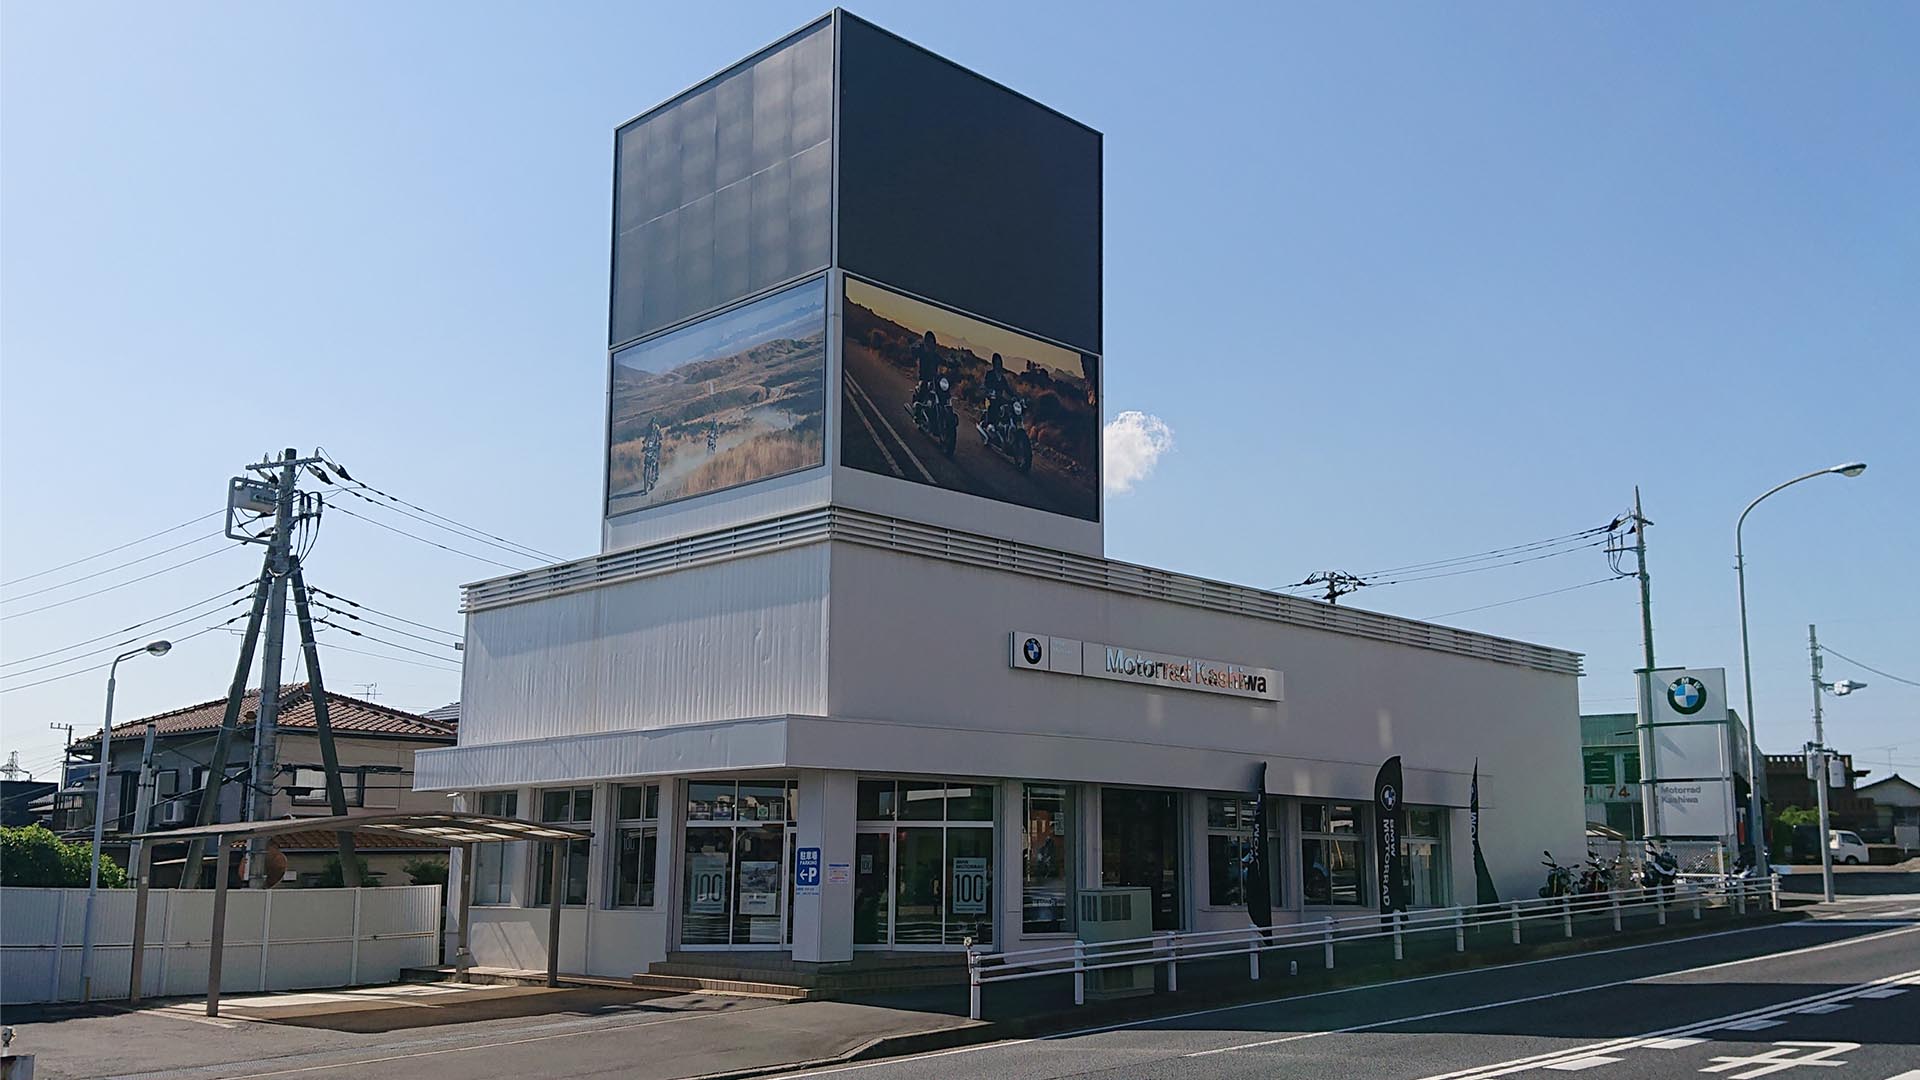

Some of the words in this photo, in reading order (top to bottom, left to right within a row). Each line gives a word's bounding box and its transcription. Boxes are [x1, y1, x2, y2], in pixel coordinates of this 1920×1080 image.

[1105, 646, 1191, 684] Motorrad
[1195, 660, 1267, 693] Kashiwa
[1670, 677, 1703, 691] BMW
[1661, 786, 1701, 794] Motorrad
[1661, 796, 1699, 804] Kashiwa
[1383, 819, 1391, 907] MOTORRAD
[809, 867, 817, 883] P
[955, 874, 984, 903] 100
